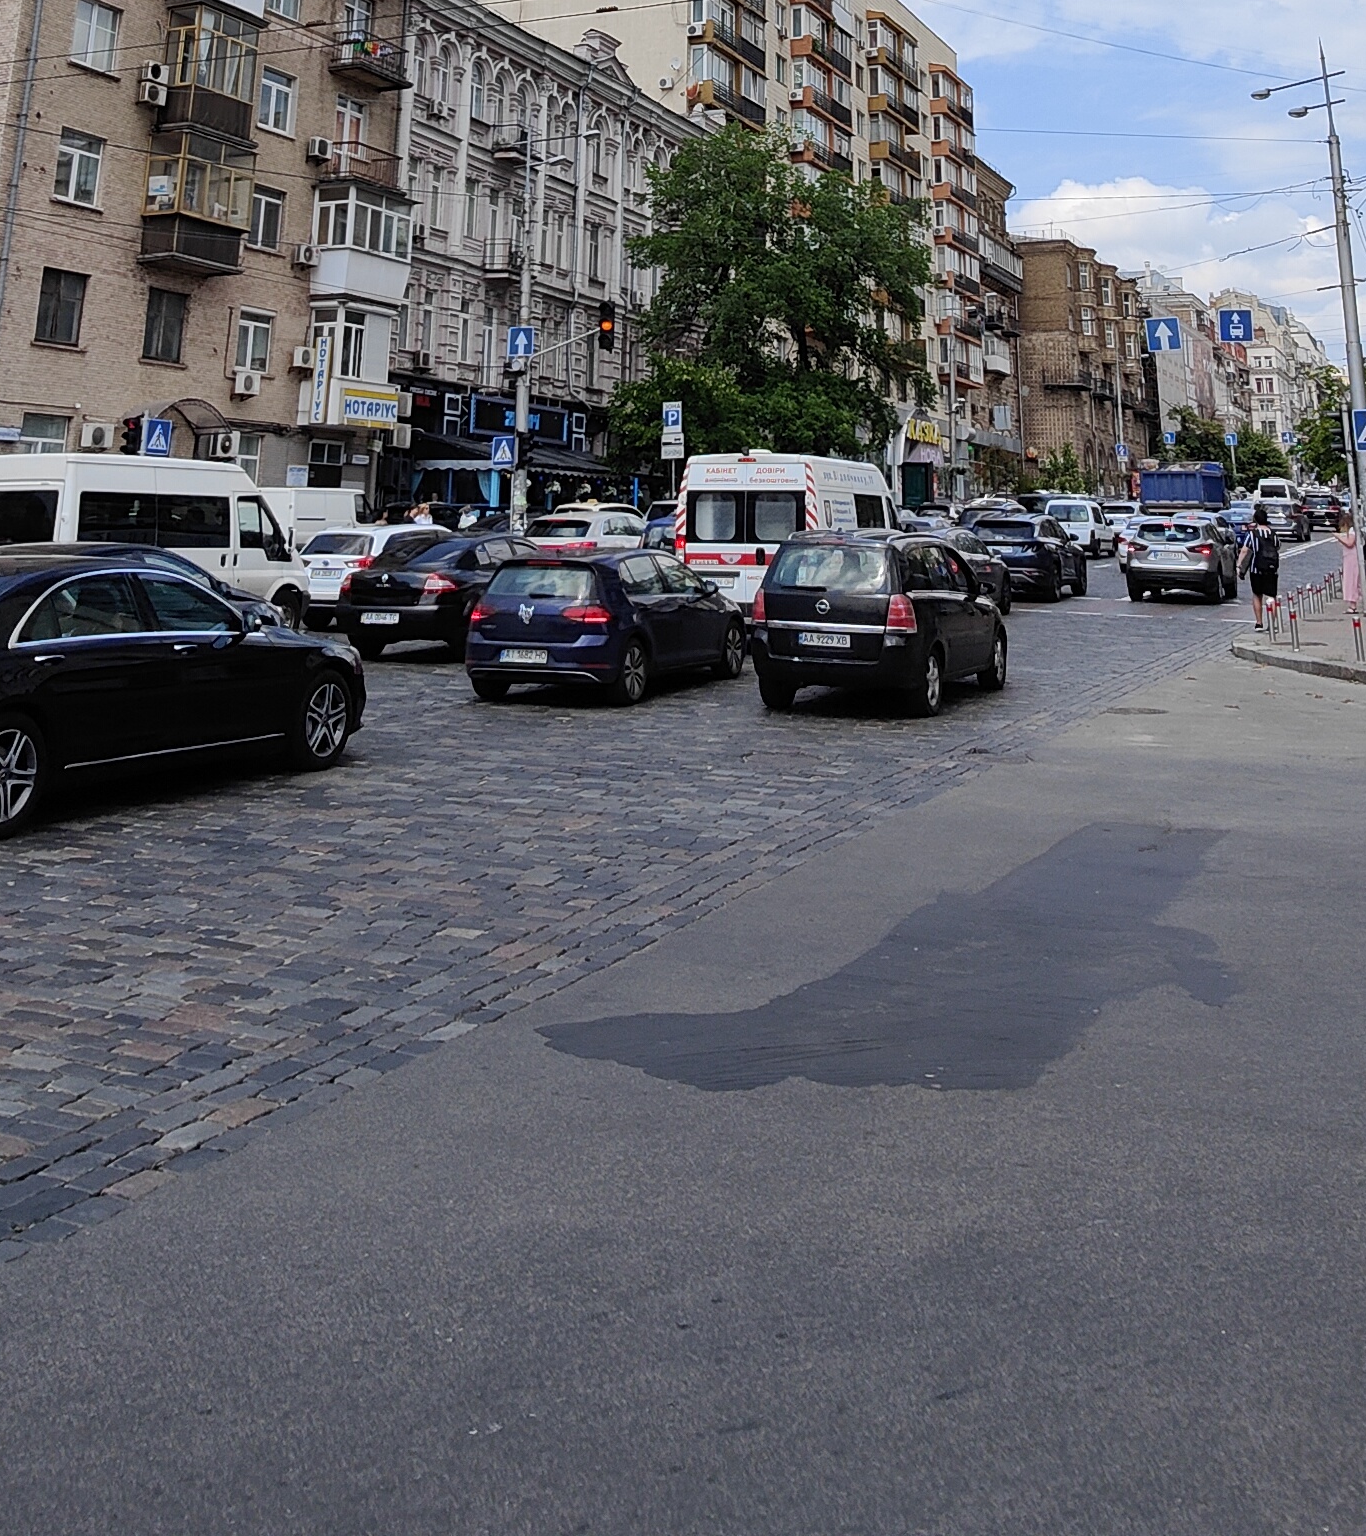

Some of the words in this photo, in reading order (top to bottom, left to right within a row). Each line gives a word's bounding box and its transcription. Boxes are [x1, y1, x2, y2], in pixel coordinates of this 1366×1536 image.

[314, 338, 327, 421] НОТАРІУС
[344, 399, 397, 419] НОТАРІУС
[668, 411, 677, 426] P
[803, 633, 815, 643] AA
